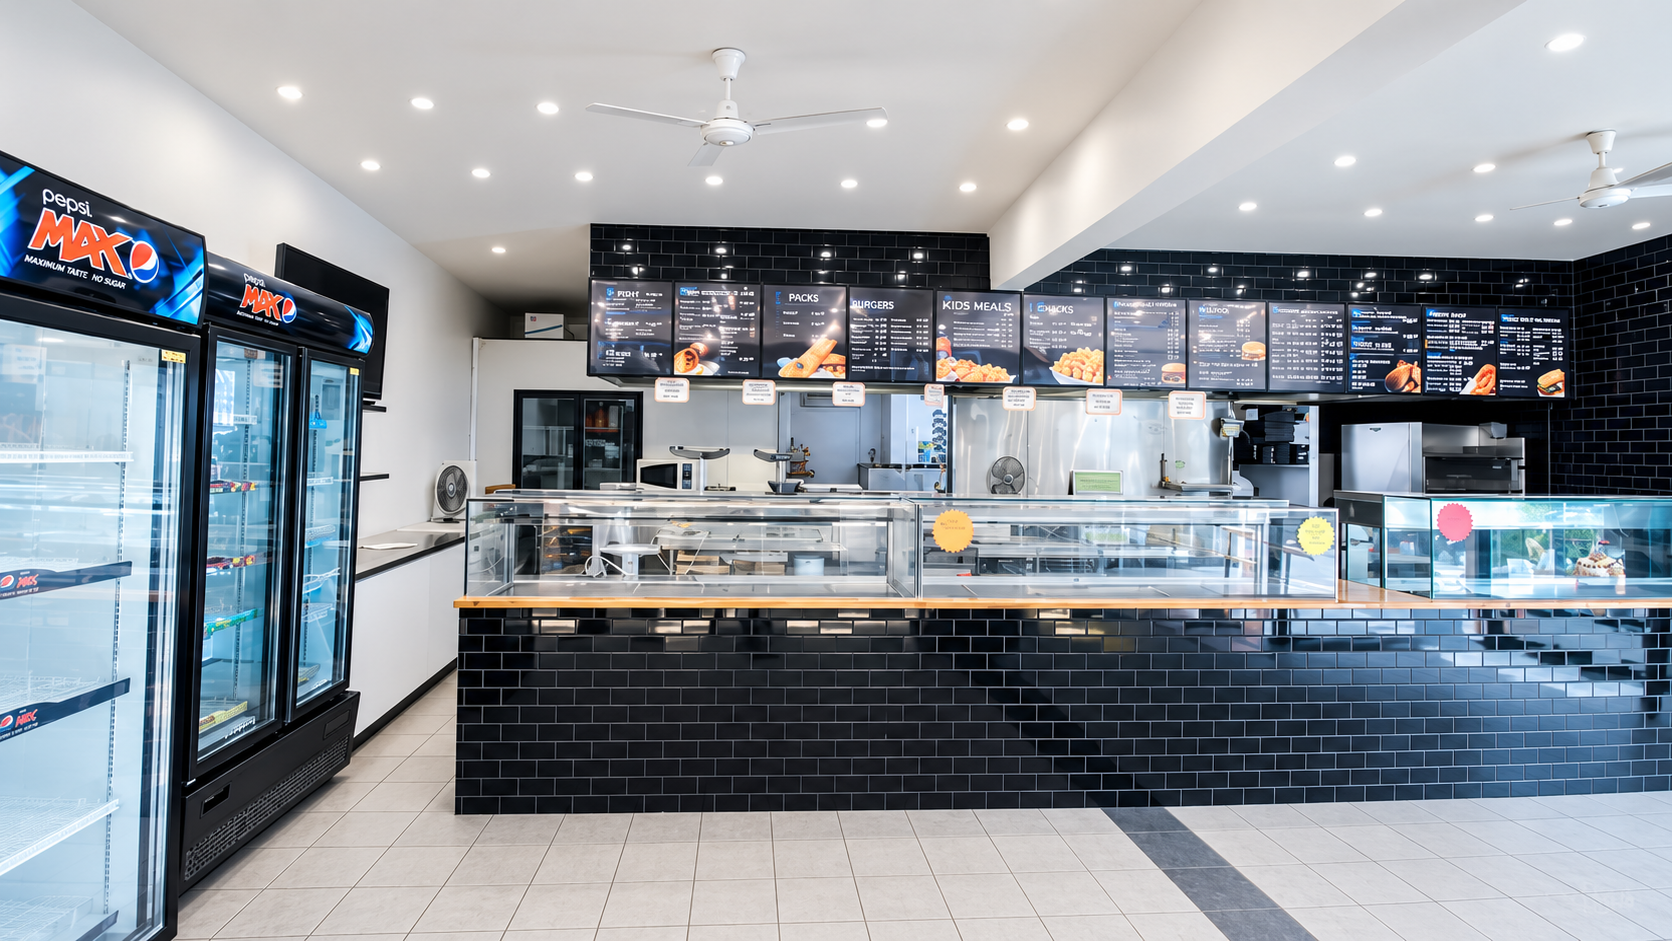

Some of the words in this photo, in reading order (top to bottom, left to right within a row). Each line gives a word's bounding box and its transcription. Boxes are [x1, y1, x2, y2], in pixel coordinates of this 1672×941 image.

[42, 188, 91, 217] pepsi
[27, 207, 133, 279] MAX
[24, 254, 66, 273] MAXIMUM
[91, 274, 103, 283] NO
[103, 276, 126, 290] SUGAR
[239, 283, 285, 322] MAX
[788, 293, 820, 303] PACKS
[851, 300, 895, 310] BURGERS
[942, 300, 971, 311] KIDS
[974, 301, 1012, 312] MEALS
